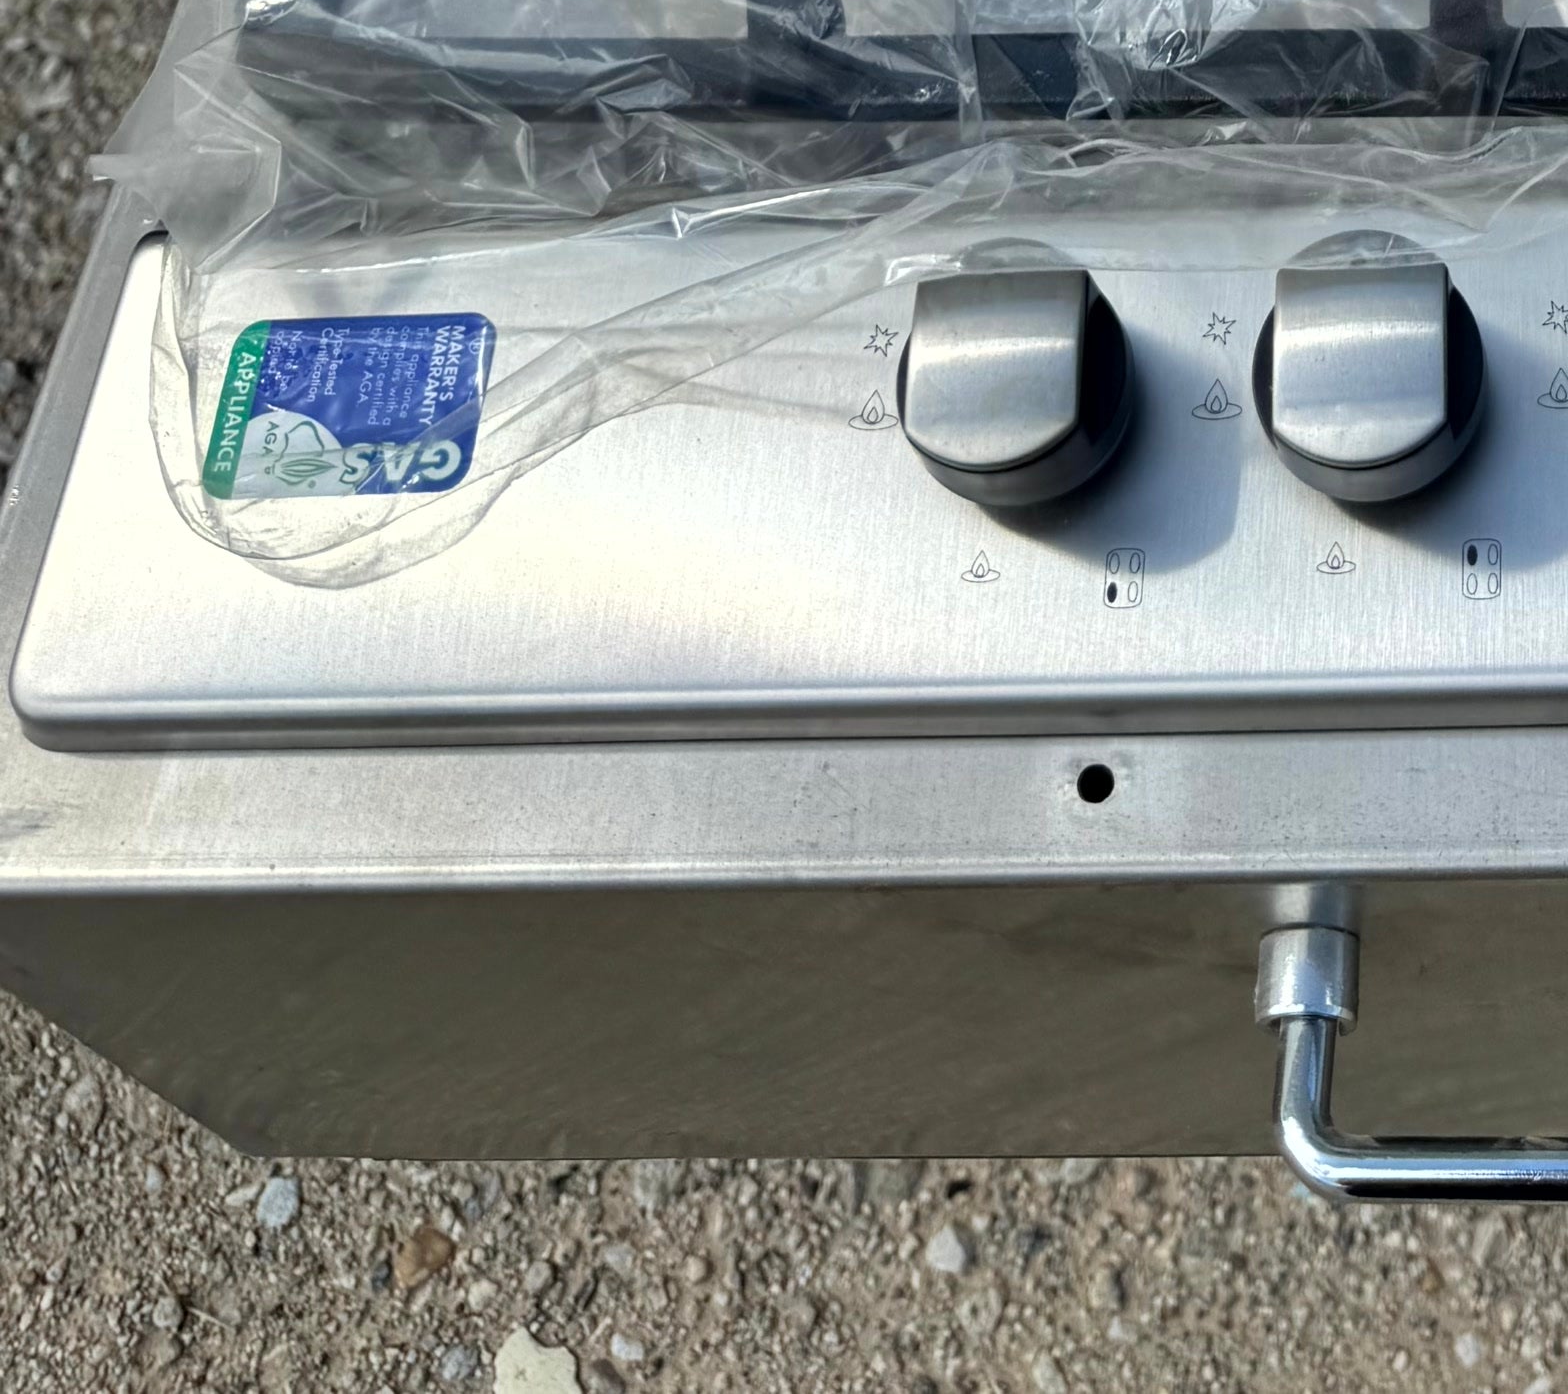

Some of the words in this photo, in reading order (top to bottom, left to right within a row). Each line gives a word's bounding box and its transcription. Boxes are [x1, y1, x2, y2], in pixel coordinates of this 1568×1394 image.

[306, 328, 333, 403] Certification
[365, 347, 376, 366] the
[419, 325, 450, 426] WARRANTY
[439, 326, 465, 401] MAKER'S
[213, 352, 256, 472] APPLIANCE
[367, 373, 385, 425] certified
[386, 387, 397, 413] with
[399, 355, 420, 418] appliance
[261, 421, 279, 457] AGA
[382, 418, 390, 426] a
[339, 441, 463, 483] GAS
